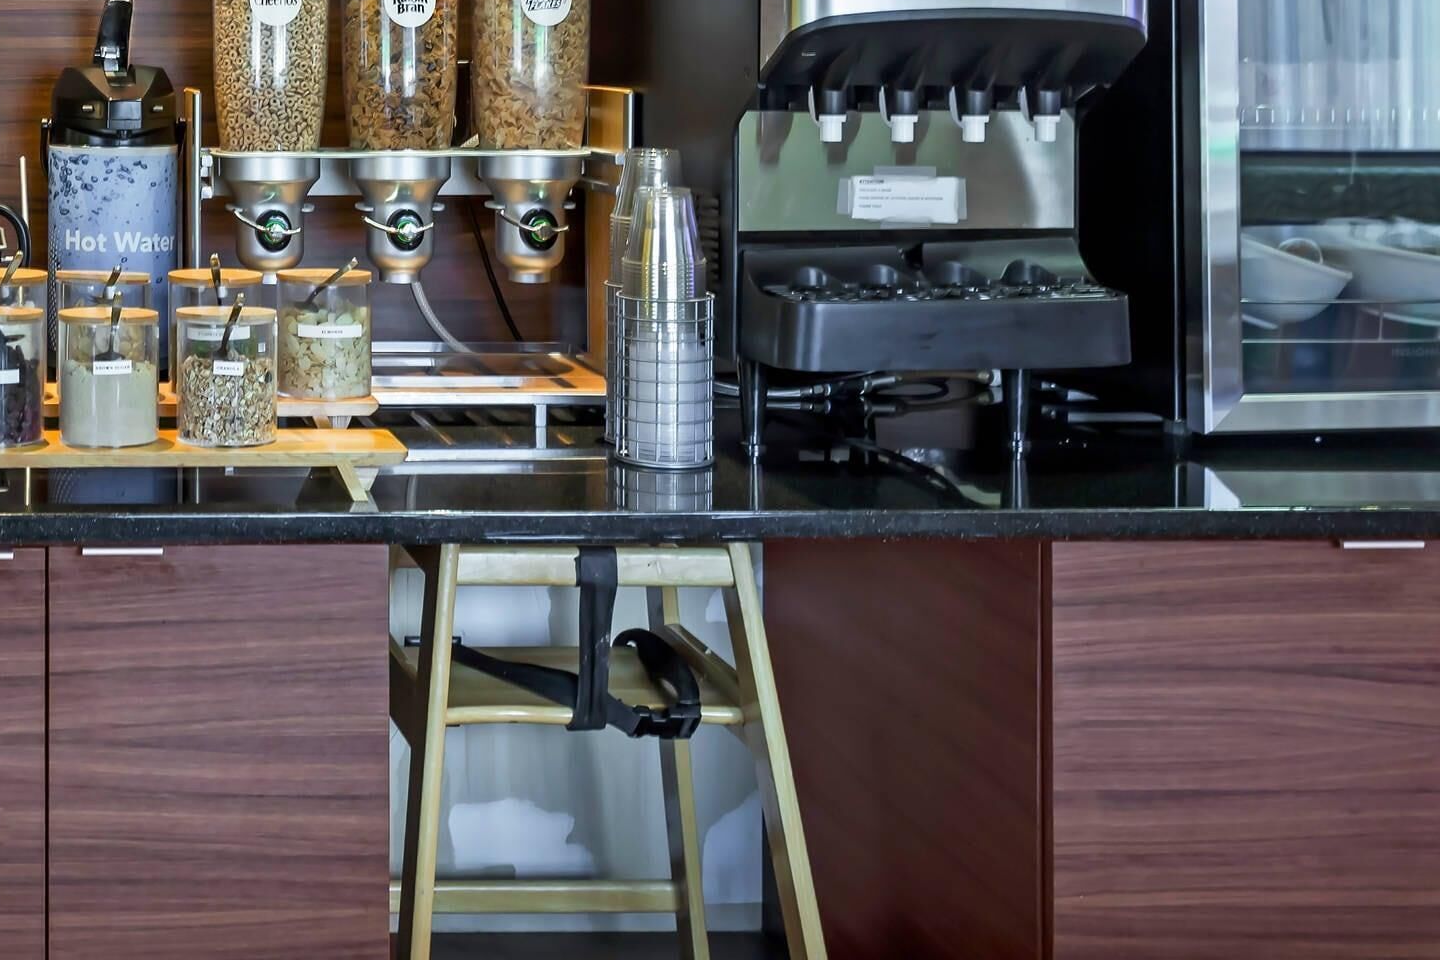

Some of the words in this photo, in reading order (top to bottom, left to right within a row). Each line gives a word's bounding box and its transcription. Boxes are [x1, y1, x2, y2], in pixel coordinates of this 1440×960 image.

[397, 3, 425, 14] Bran
[65, 228, 107, 252] Hot
[113, 231, 175, 253] Water
